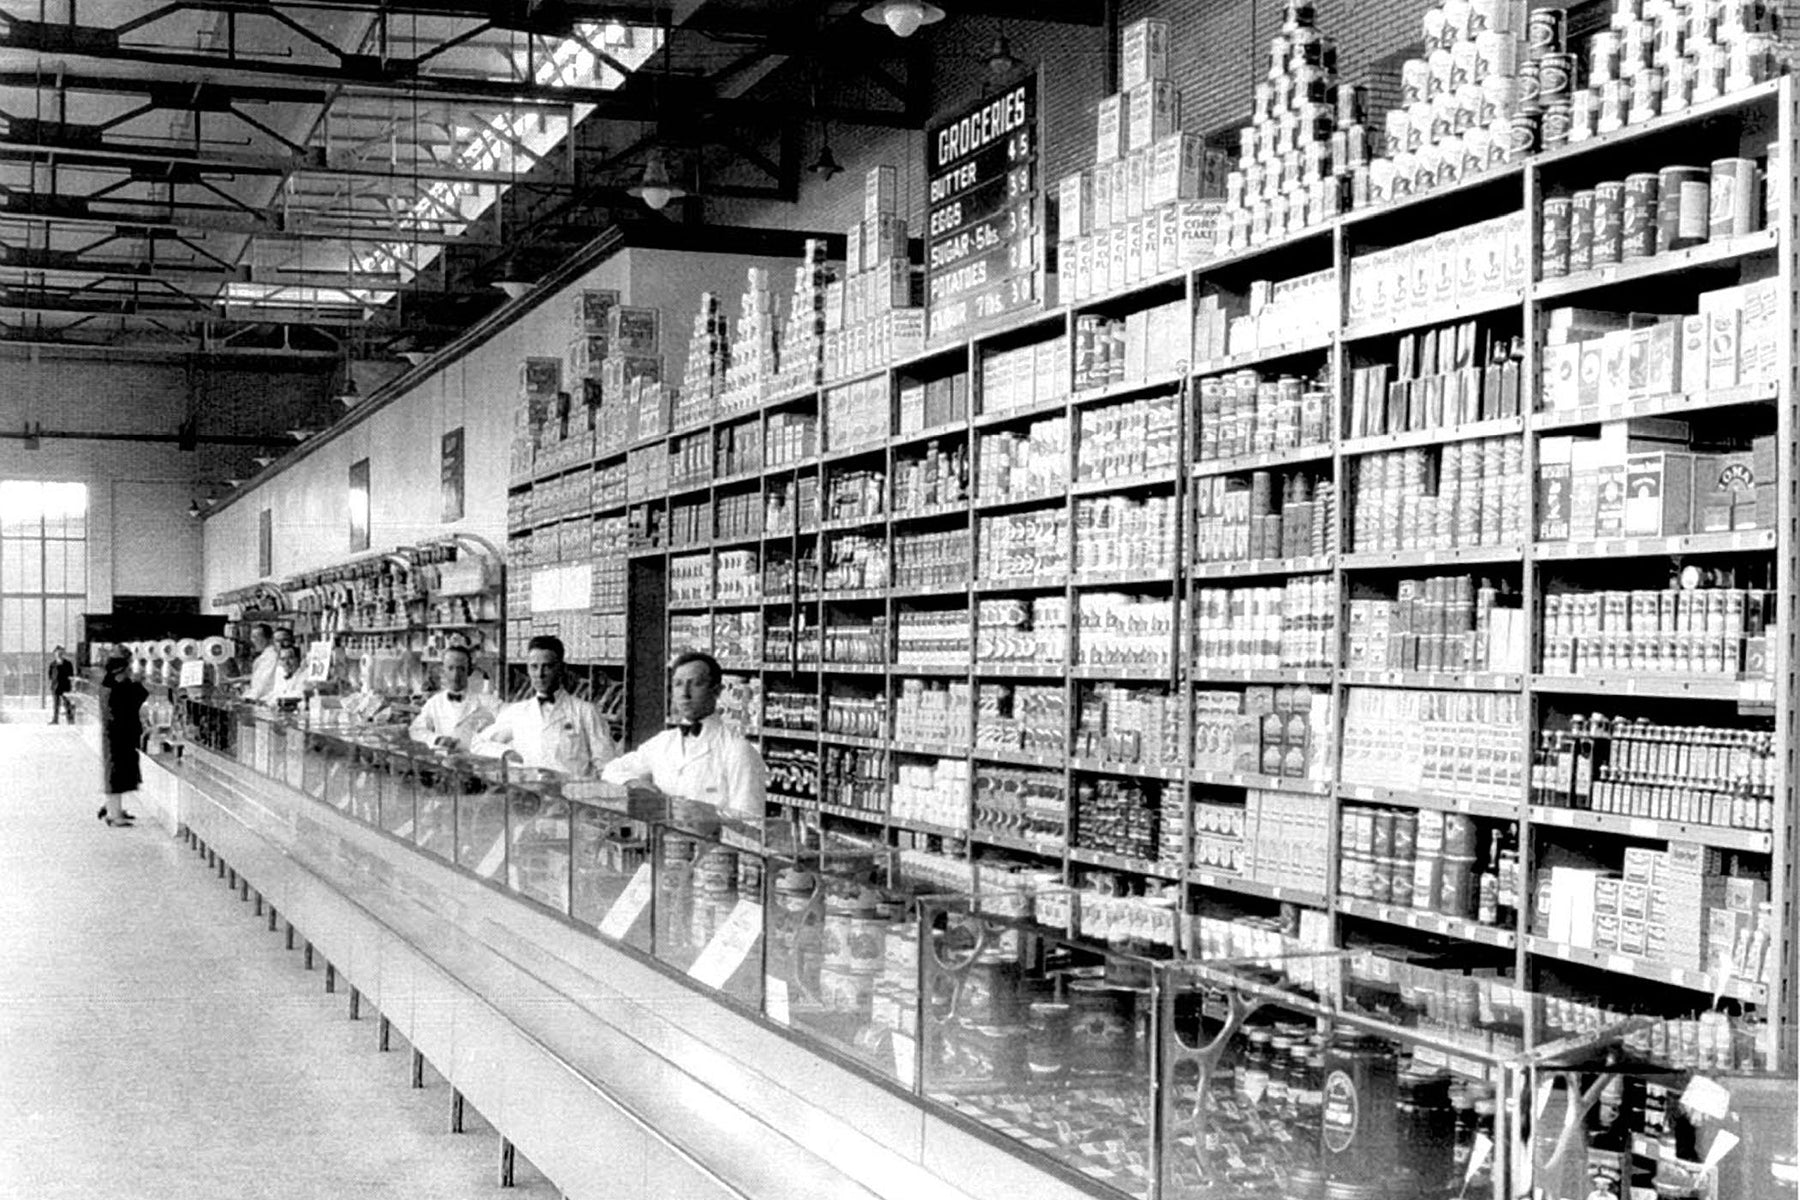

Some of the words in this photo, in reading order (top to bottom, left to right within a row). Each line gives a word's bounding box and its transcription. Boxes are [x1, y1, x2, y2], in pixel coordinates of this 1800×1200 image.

[938, 86, 1025, 166] GROCERIES
[930, 161, 977, 202] BUTTER
[1008, 132, 1028, 161] 45
[930, 202, 962, 236] EGGS
